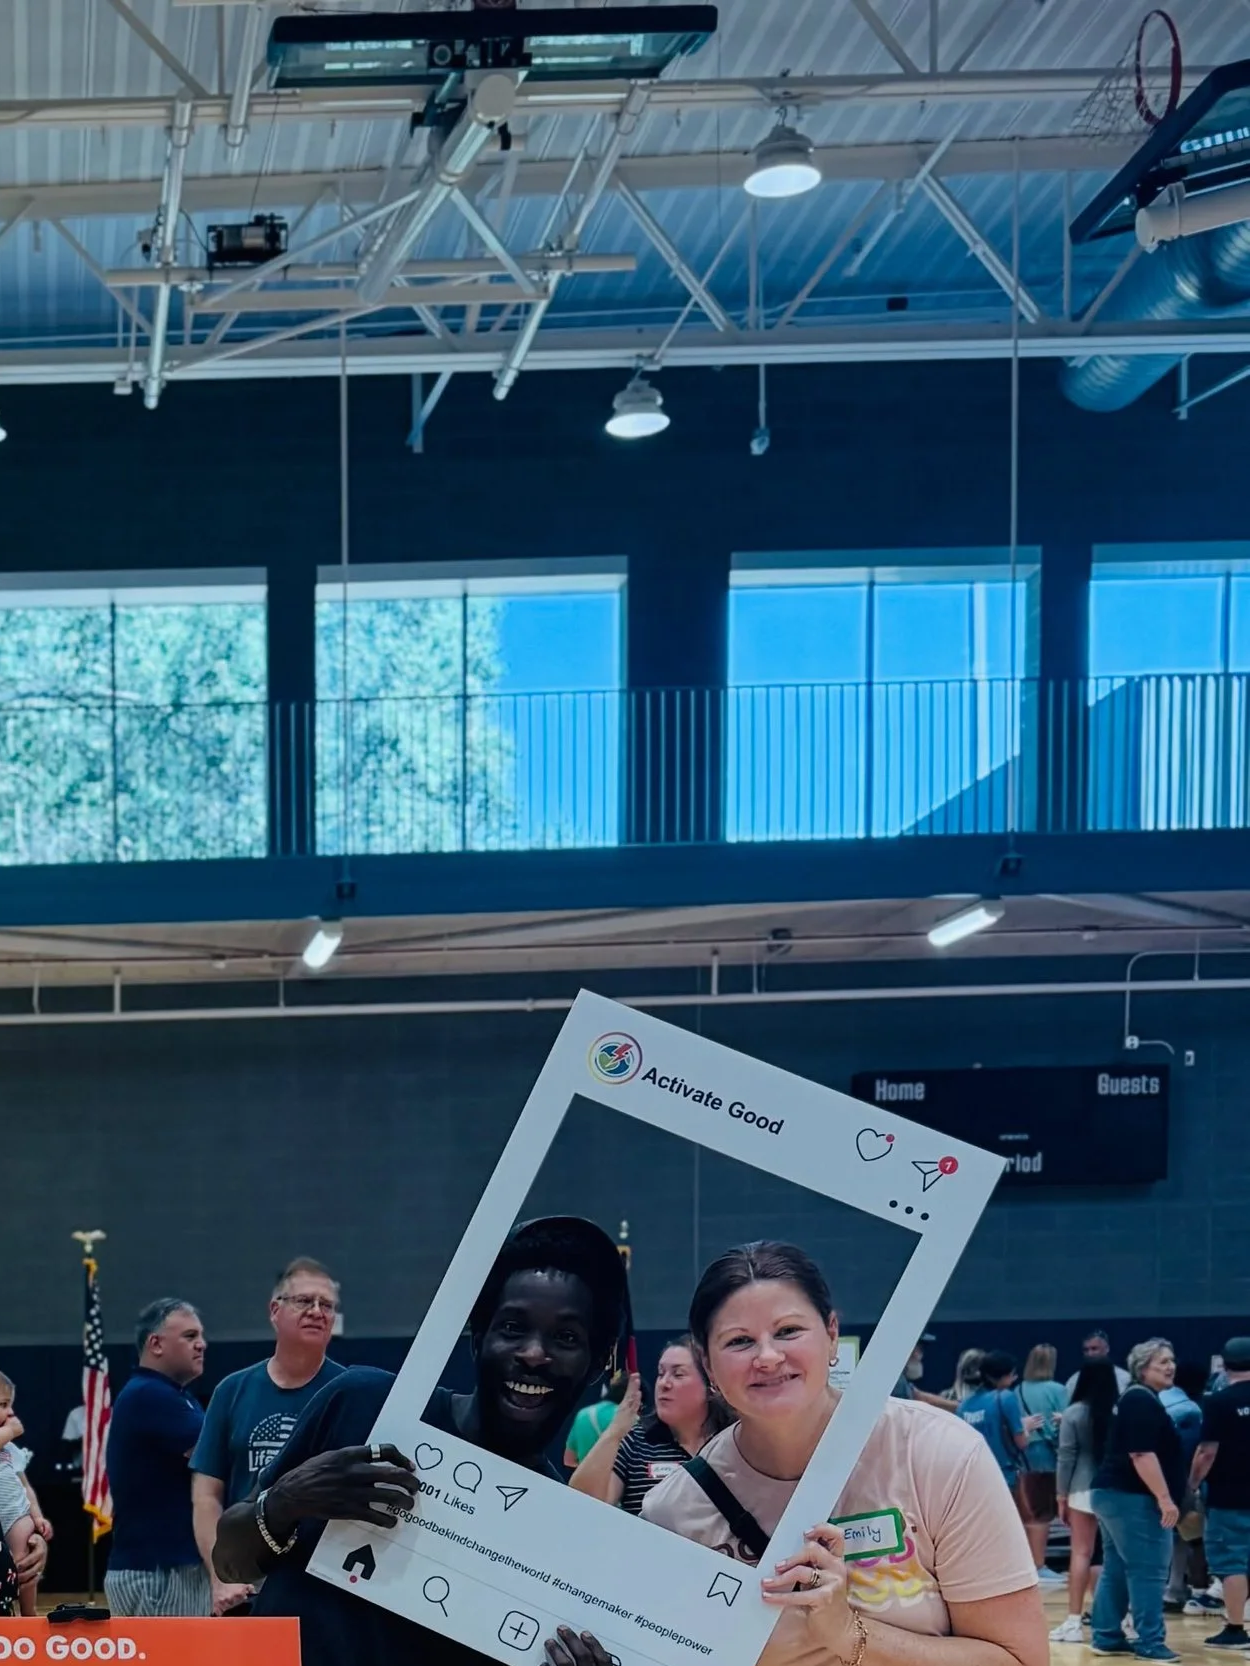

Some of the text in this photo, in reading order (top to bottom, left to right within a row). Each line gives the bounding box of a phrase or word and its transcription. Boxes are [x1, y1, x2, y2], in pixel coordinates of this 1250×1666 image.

[875, 1078, 926, 1101] Home
[1097, 1072, 1161, 1096] Guests
[641, 1066, 786, 1137] Activate Good
[1006, 1151, 1043, 1173] riod
[419, 1481, 476, 1515] 001 Likes
[844, 1526, 881, 1543] Emily
[386, 1503, 714, 1656] #dogoodbekindchangetheworld #changemaker #peoplepower
[46, 1635, 146, 1660] GOOD.
